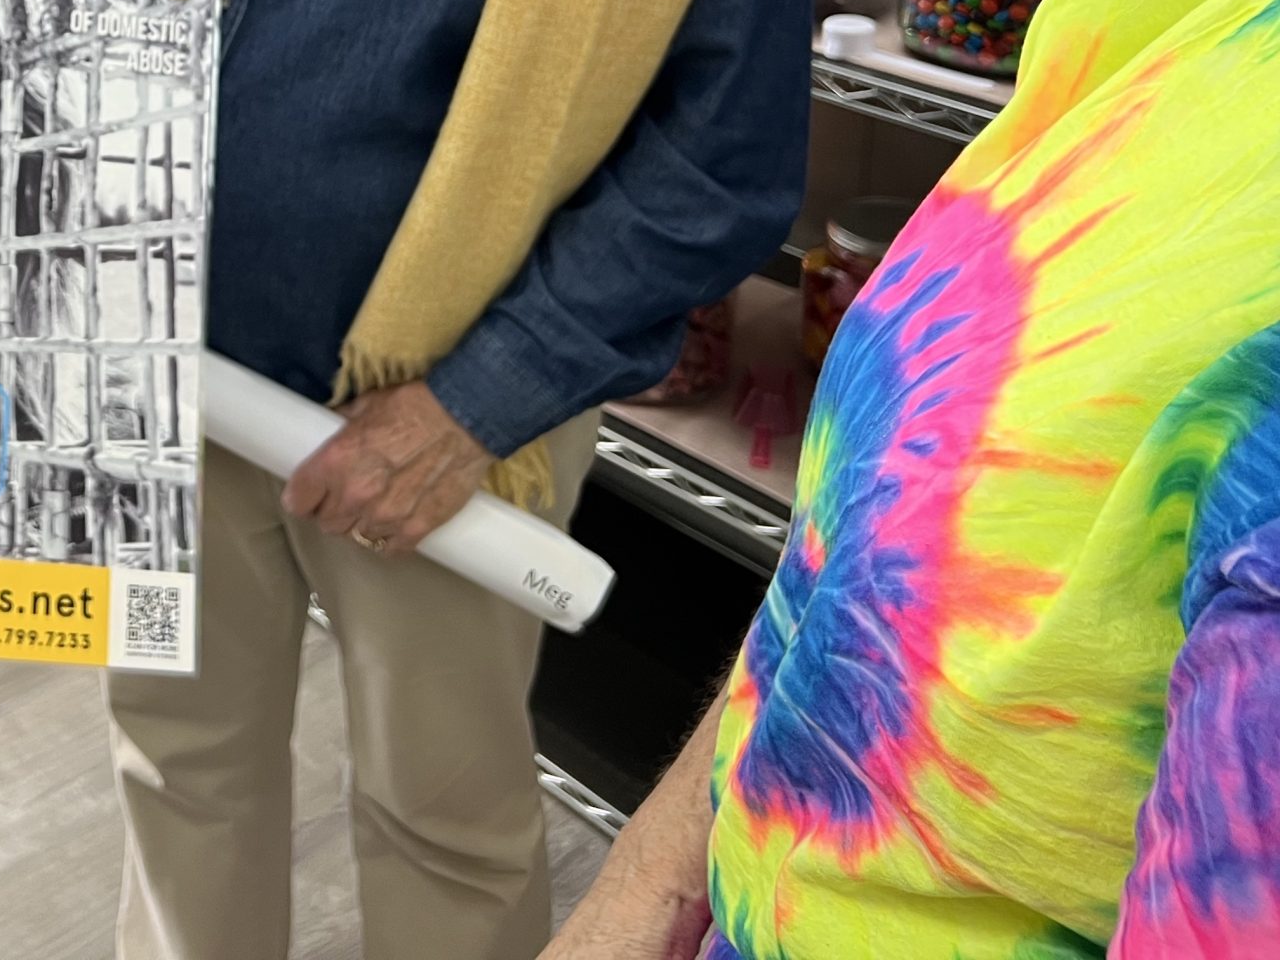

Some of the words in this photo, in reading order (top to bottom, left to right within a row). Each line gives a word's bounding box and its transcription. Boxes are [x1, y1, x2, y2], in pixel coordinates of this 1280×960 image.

[70, 9, 93, 34] OF
[97, 11, 187, 44] DOMESTIC
[127, 48, 186, 76] ABUSE
[522, 568, 574, 611] Meg
